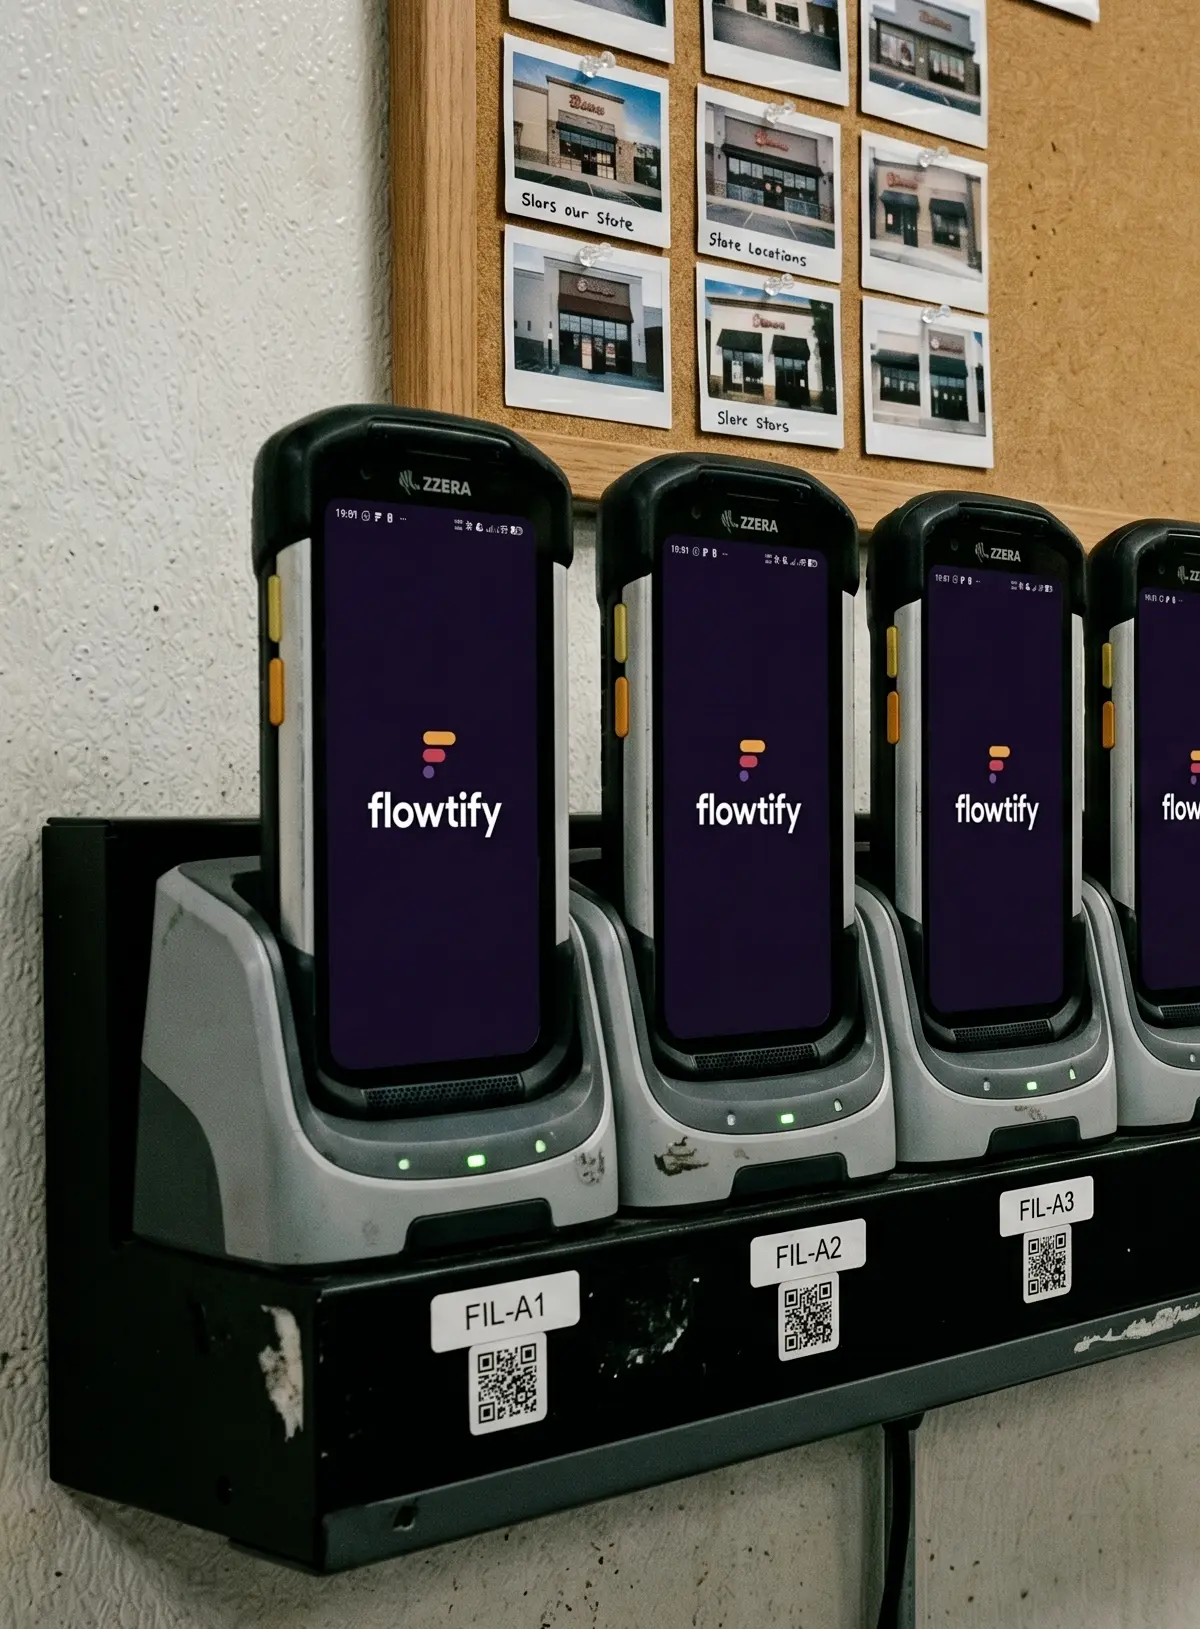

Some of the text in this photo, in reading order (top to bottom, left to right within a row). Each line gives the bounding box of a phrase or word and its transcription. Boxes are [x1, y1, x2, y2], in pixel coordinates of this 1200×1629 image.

[565, 206, 589, 219] our
[748, 242, 807, 267] Locations
[422, 476, 472, 496] ZZERA
[740, 516, 779, 533] ZZERA
[990, 547, 1021, 562] ZZERA
[367, 791, 502, 838] flowtify
[696, 792, 802, 834] flowtify
[955, 793, 1040, 831] flowtify
[1019, 1190, 1075, 1222] FIL-A3
[775, 1235, 843, 1270] FIL-A2
[464, 1291, 546, 1331] FIL-A1
